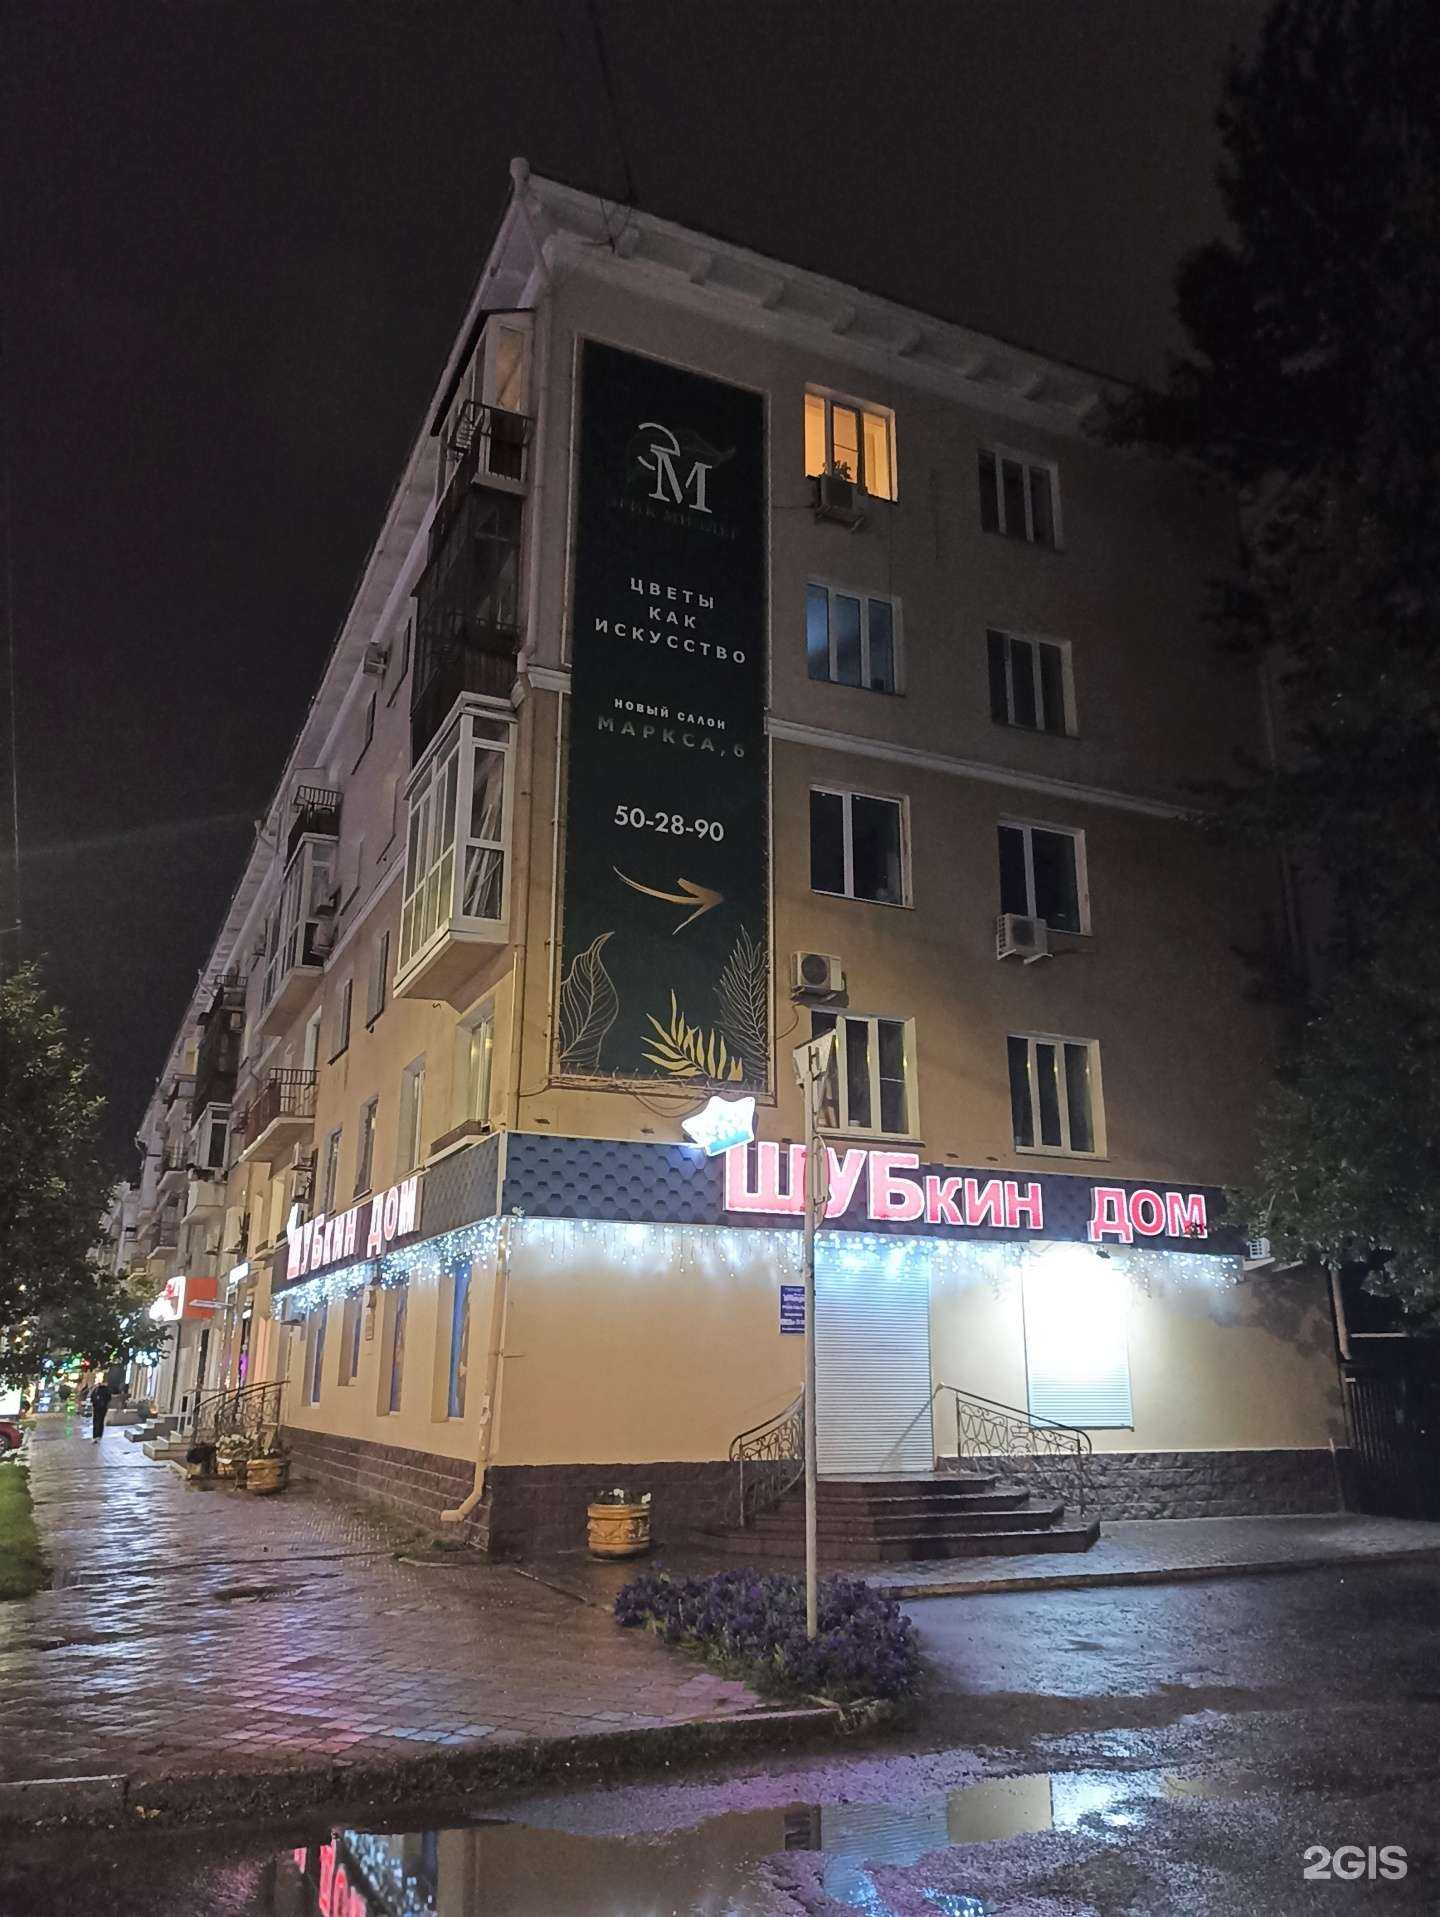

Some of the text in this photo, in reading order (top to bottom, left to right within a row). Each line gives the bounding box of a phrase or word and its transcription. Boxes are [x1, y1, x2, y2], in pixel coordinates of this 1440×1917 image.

[630, 577, 714, 609] ЦВЕТЫ
[649, 606, 696, 629] КАК
[595, 618, 746, 664] ИСКУССТВО
[614, 698, 725, 730] НОВЫЙ САЛОН
[614, 805, 724, 842] 50-28-90
